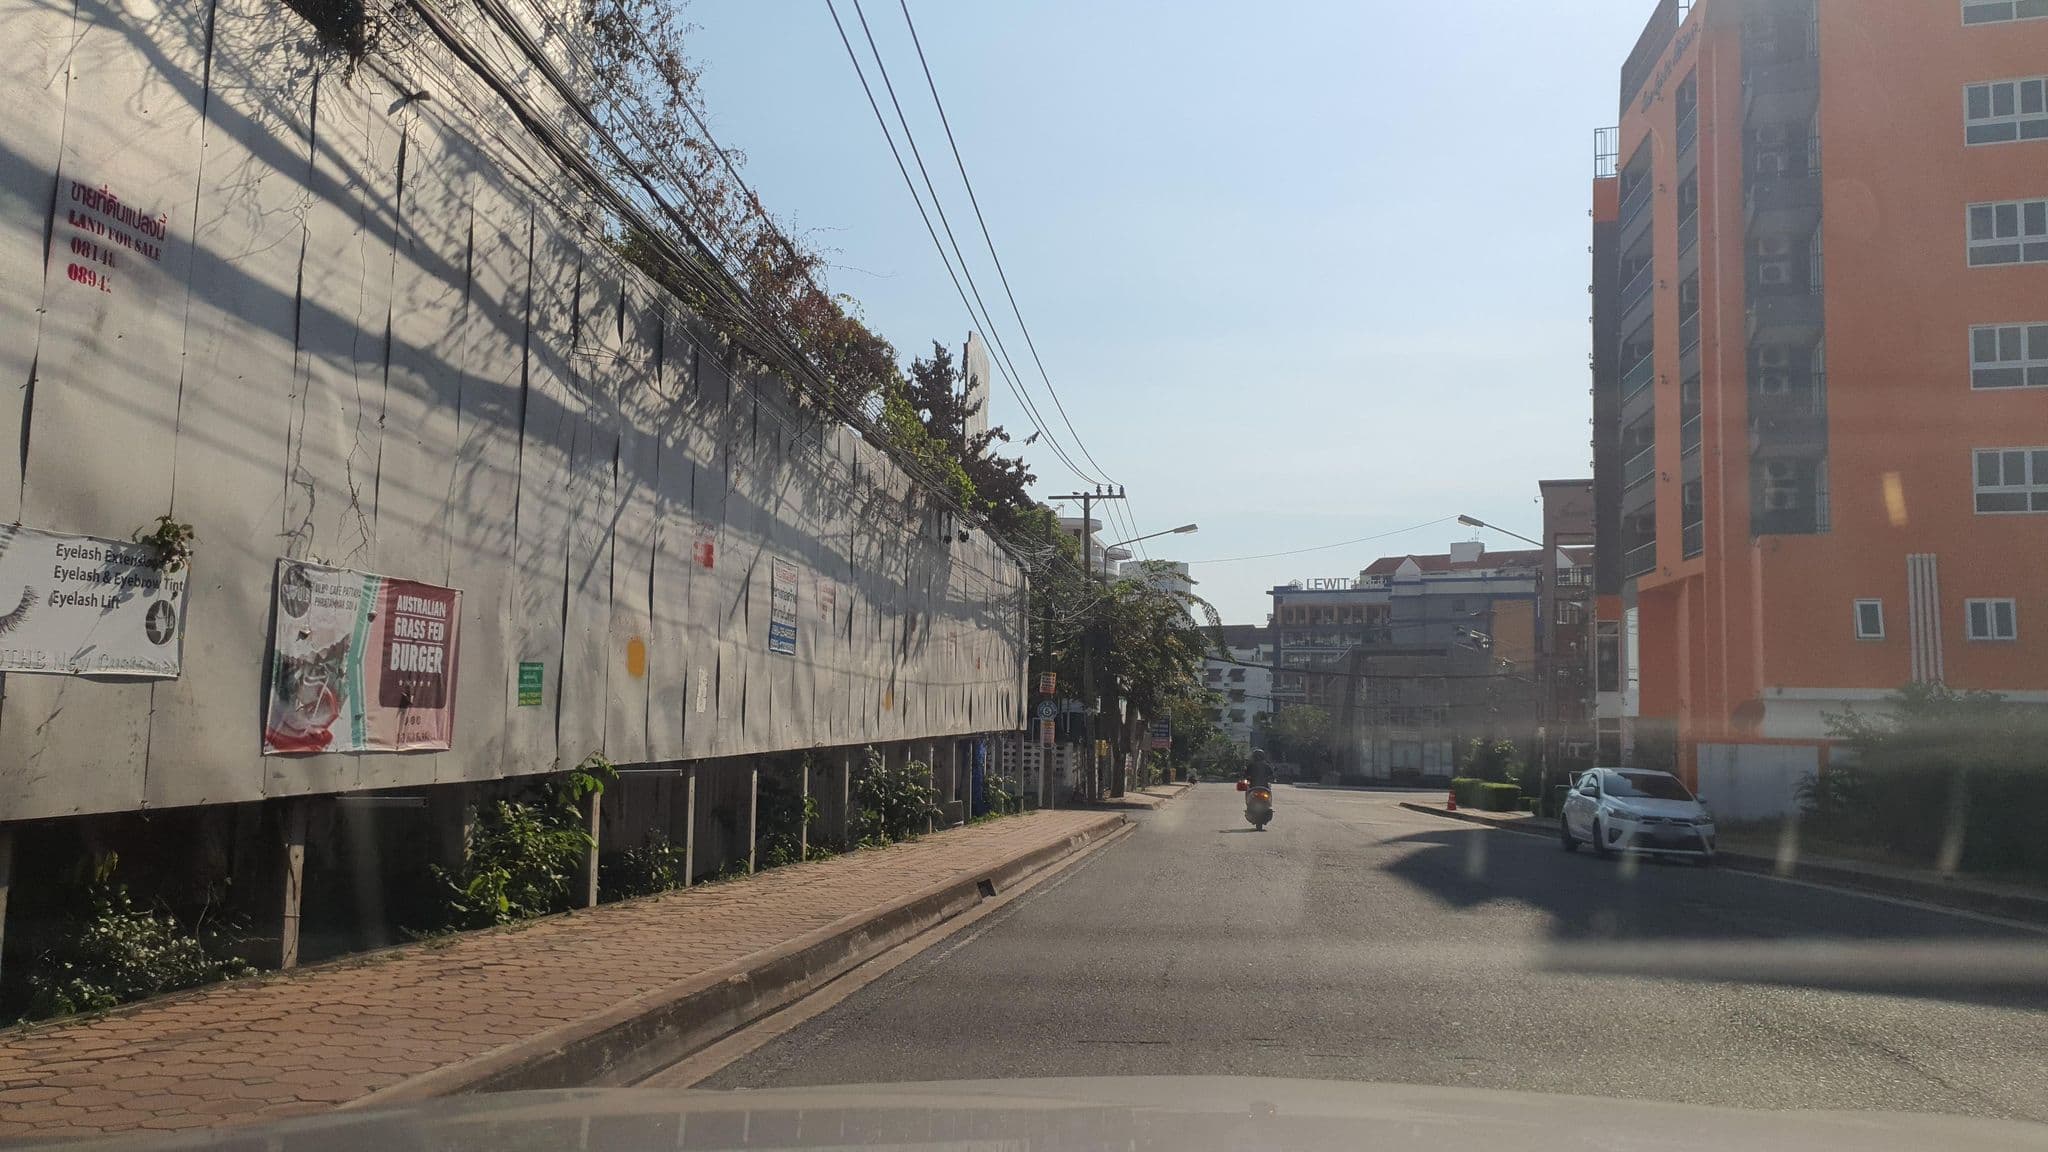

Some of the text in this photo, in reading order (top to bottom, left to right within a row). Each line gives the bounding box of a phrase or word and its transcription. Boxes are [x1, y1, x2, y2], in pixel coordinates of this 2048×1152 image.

[71, 181, 167, 241] ขายที่ดินแปลงนี้
[68, 208, 162, 261] LAND FOR SALE
[56, 543, 102, 561] Eyelash
[54, 565, 184, 592] Eyelash & Eyebrow Tint
[1306, 577, 1350, 590] LEWIT
[53, 590, 120, 609] Eyelash Lift
[396, 595, 447, 618] AUSTRALIAN
[394, 616, 445, 641] GRASS FED
[390, 642, 443, 674] BURGER
